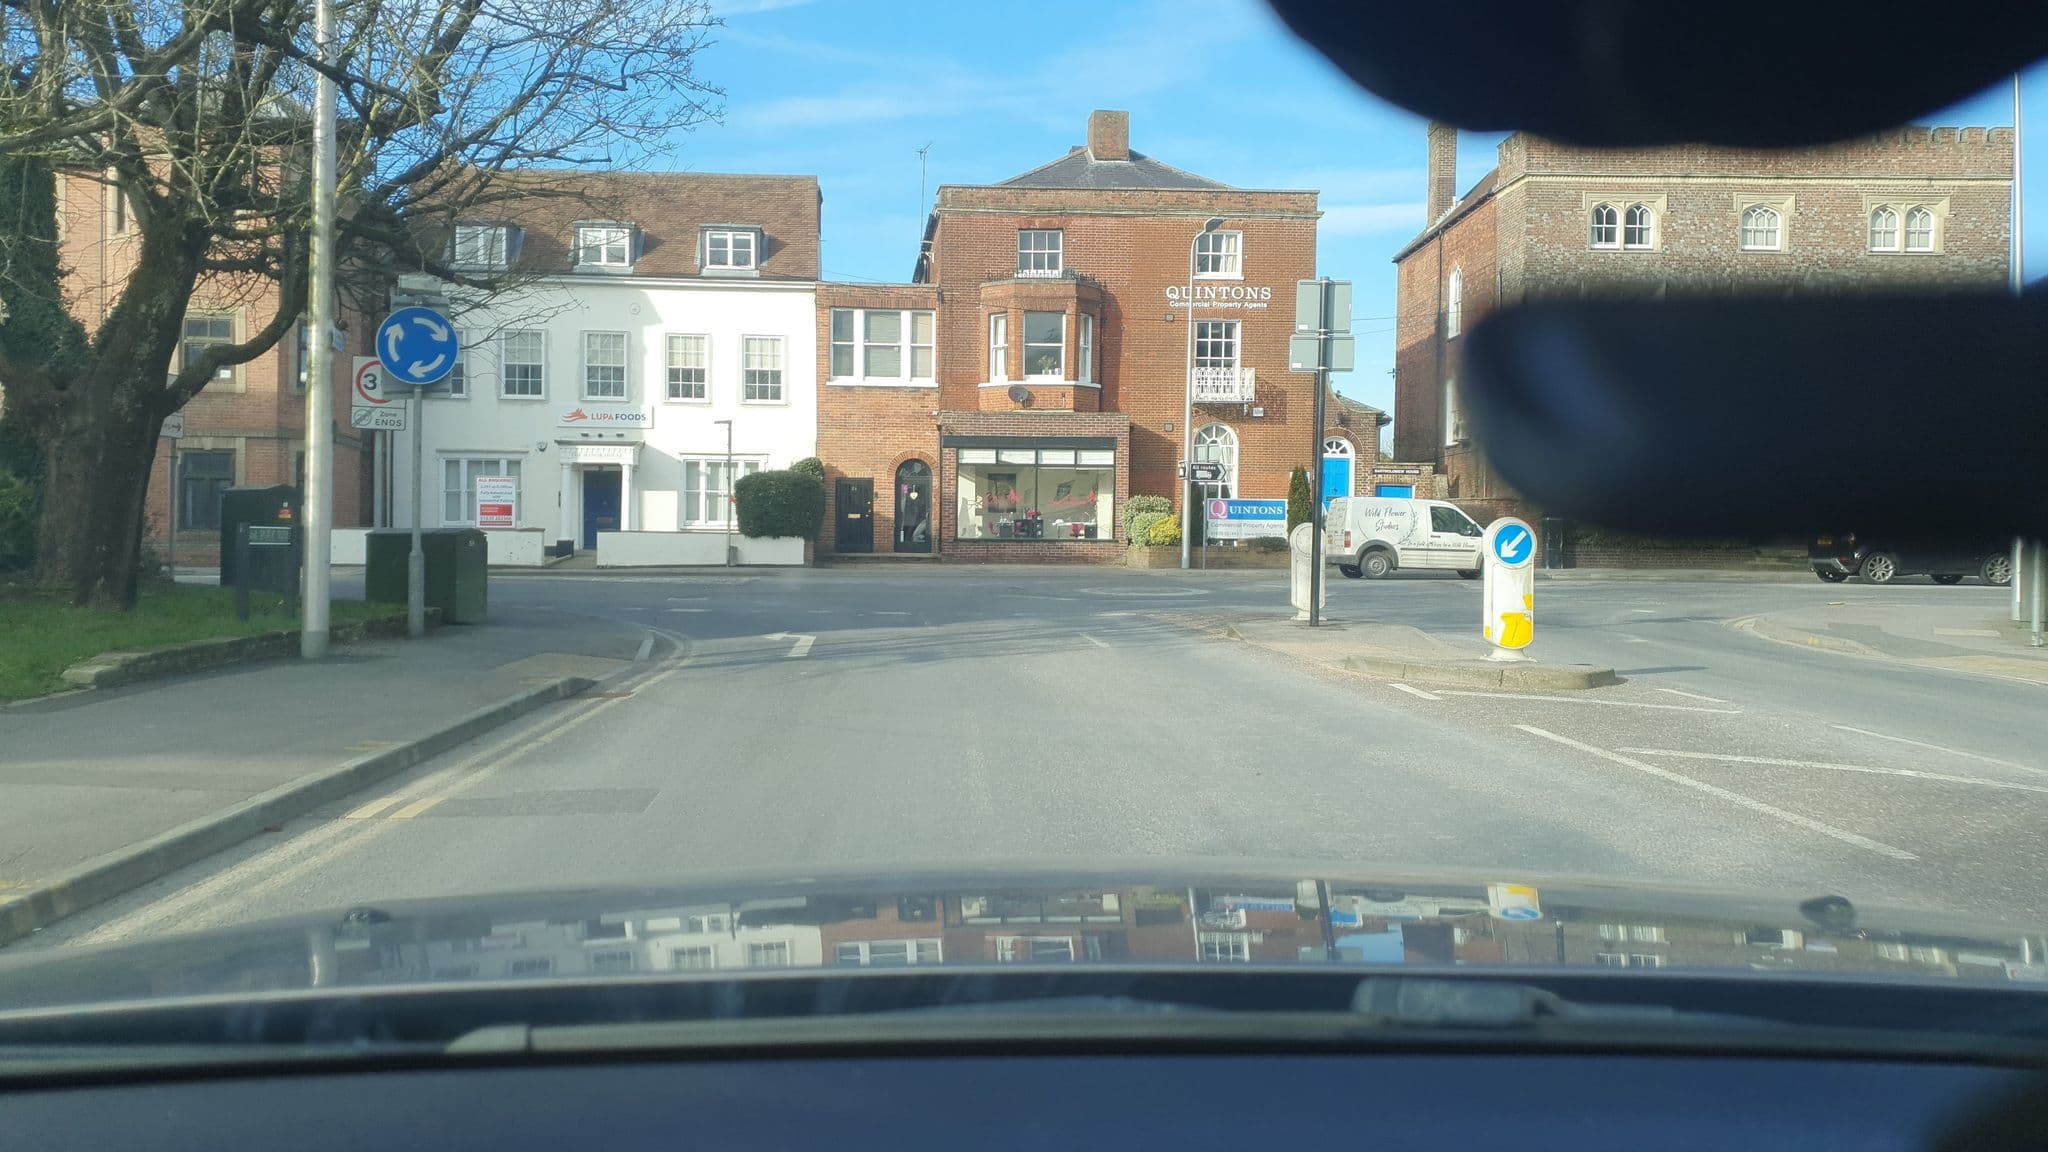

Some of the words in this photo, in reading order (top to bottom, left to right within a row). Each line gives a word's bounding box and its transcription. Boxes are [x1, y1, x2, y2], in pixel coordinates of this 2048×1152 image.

[1166, 286, 1271, 300] QUINTONS
[1213, 301, 1241, 309] Property
[1244, 301, 1267, 309] Agents
[363, 373, 377, 390] 3
[1210, 500, 1283, 518] QUINTONS
[1365, 507, 1381, 517] Wild
[1384, 506, 1407, 517] Flower
